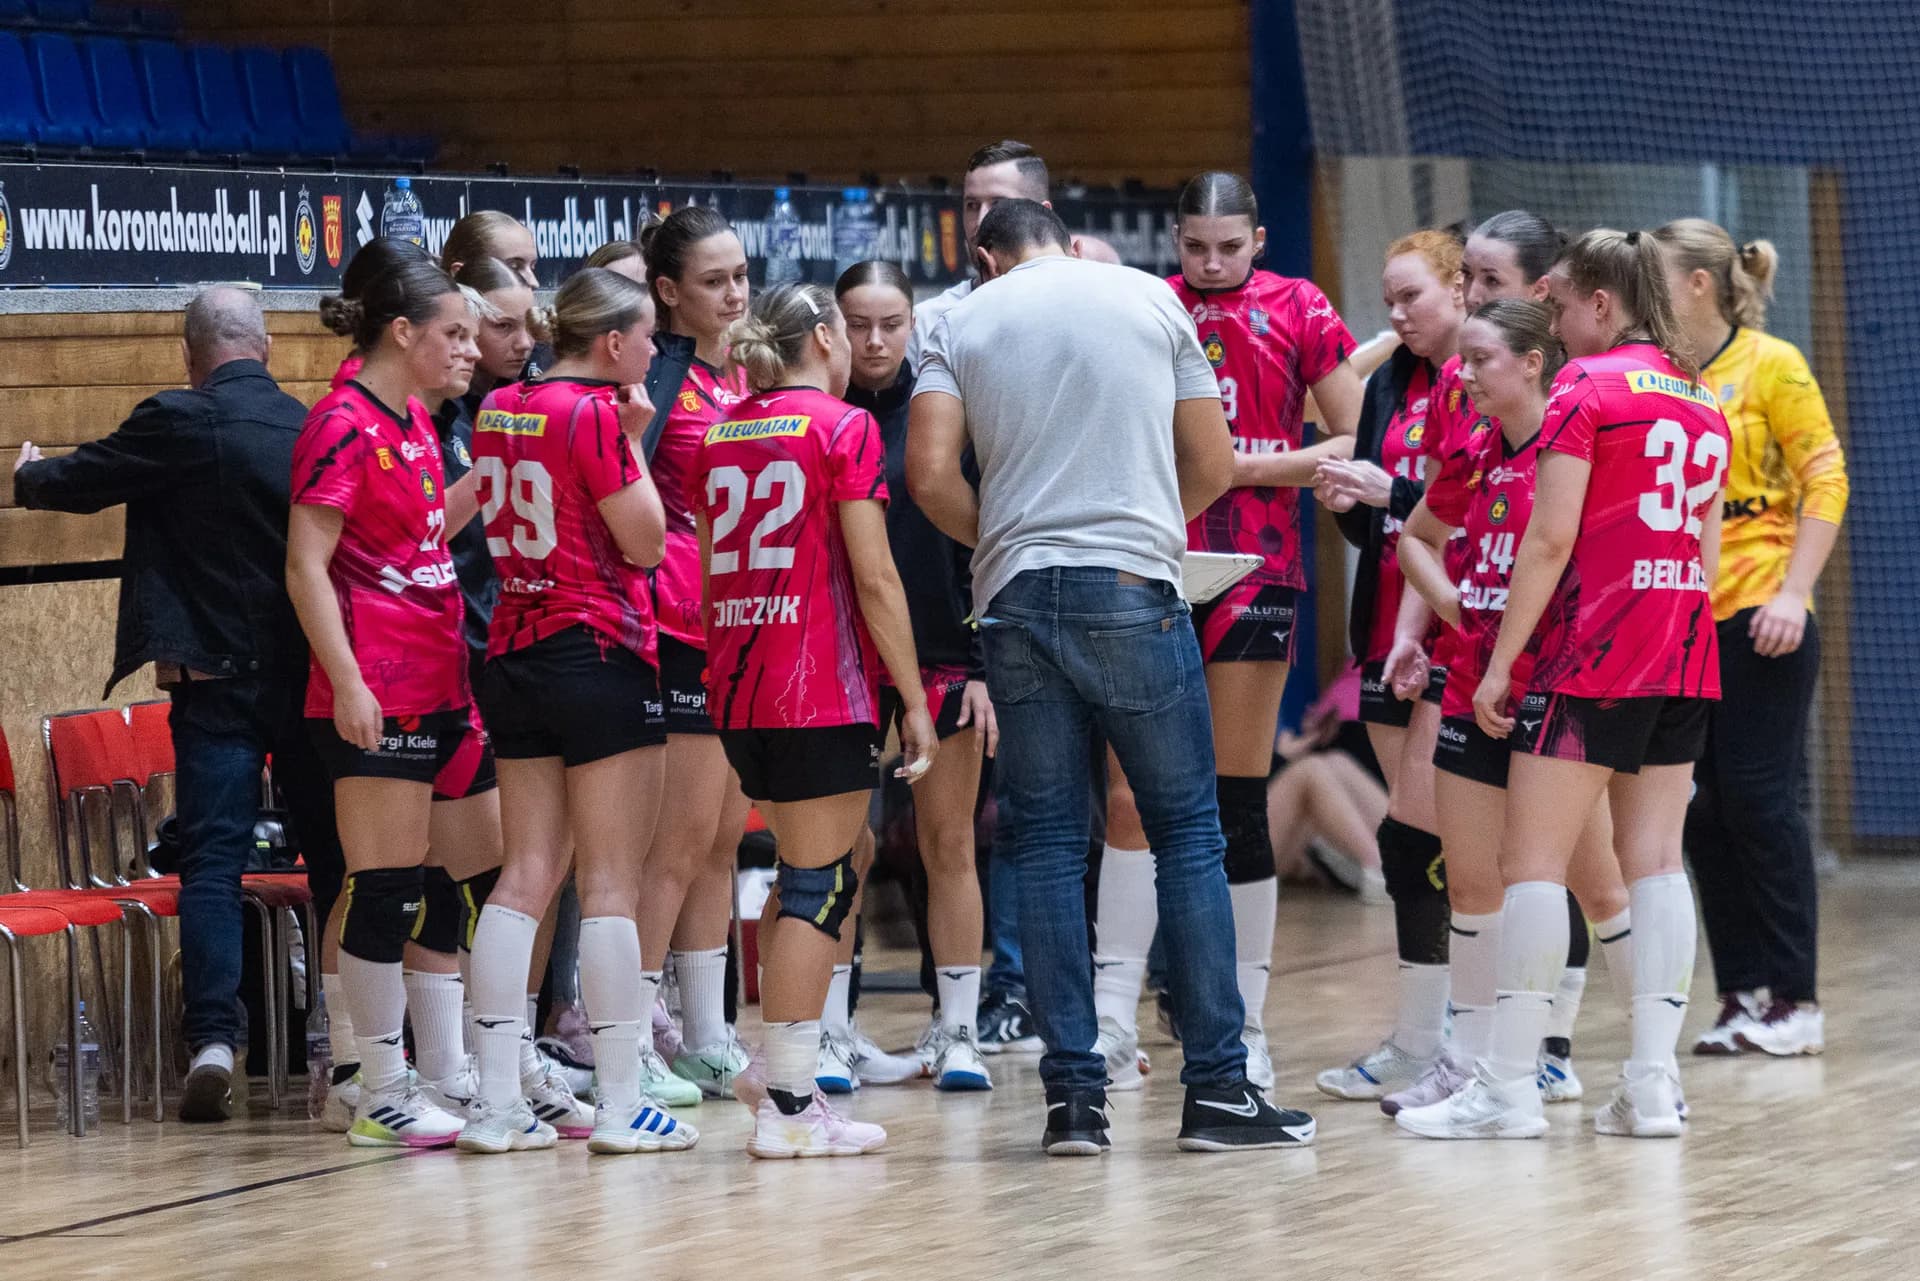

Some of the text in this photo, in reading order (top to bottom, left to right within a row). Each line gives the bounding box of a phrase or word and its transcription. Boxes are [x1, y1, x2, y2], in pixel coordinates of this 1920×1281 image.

[20, 183, 288, 276] www.koronahandball.pl
[725, 419, 802, 438] LEWIATAN
[472, 456, 557, 560] 29
[705, 460, 807, 576] 22
[1637, 418, 1728, 540] 32
[1475, 533, 1515, 574] 14
[670, 690, 706, 707] Targi
